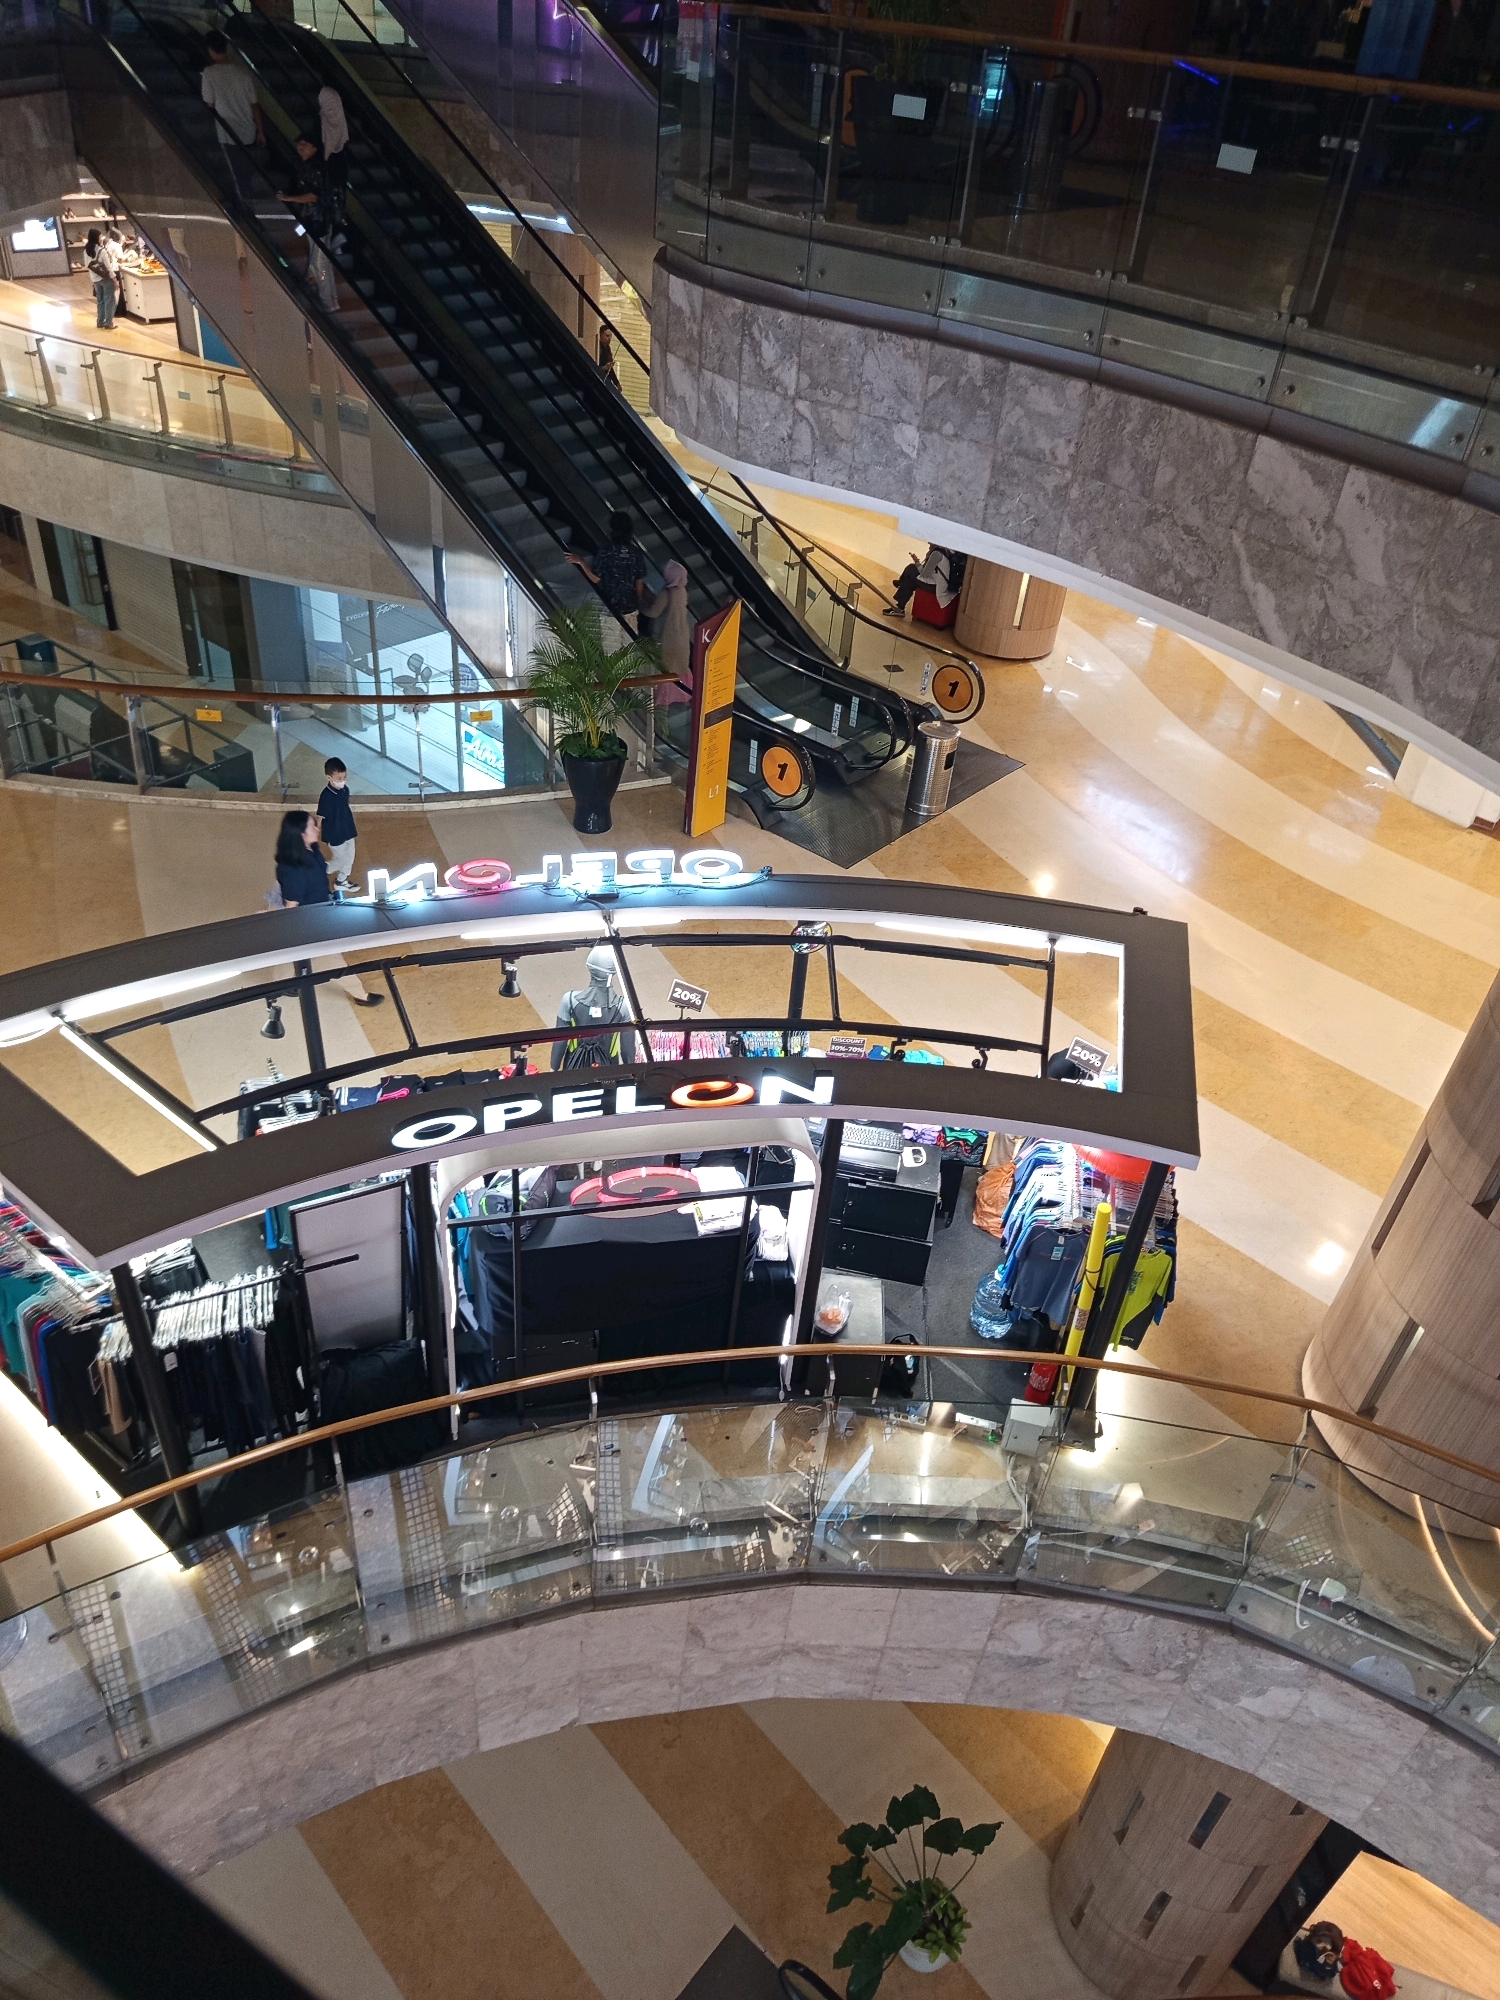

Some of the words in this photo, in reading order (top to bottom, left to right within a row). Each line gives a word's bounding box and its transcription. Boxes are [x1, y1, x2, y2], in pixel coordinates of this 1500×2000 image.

[701, 628, 711, 644] K
[948, 680, 960, 698] 1
[777, 762, 789, 781] 1
[708, 784, 720, 799] L1
[672, 987, 702, 1006] 20%
[1071, 1046, 1102, 1067] 20%
[391, 1070, 835, 1149] OPELON
